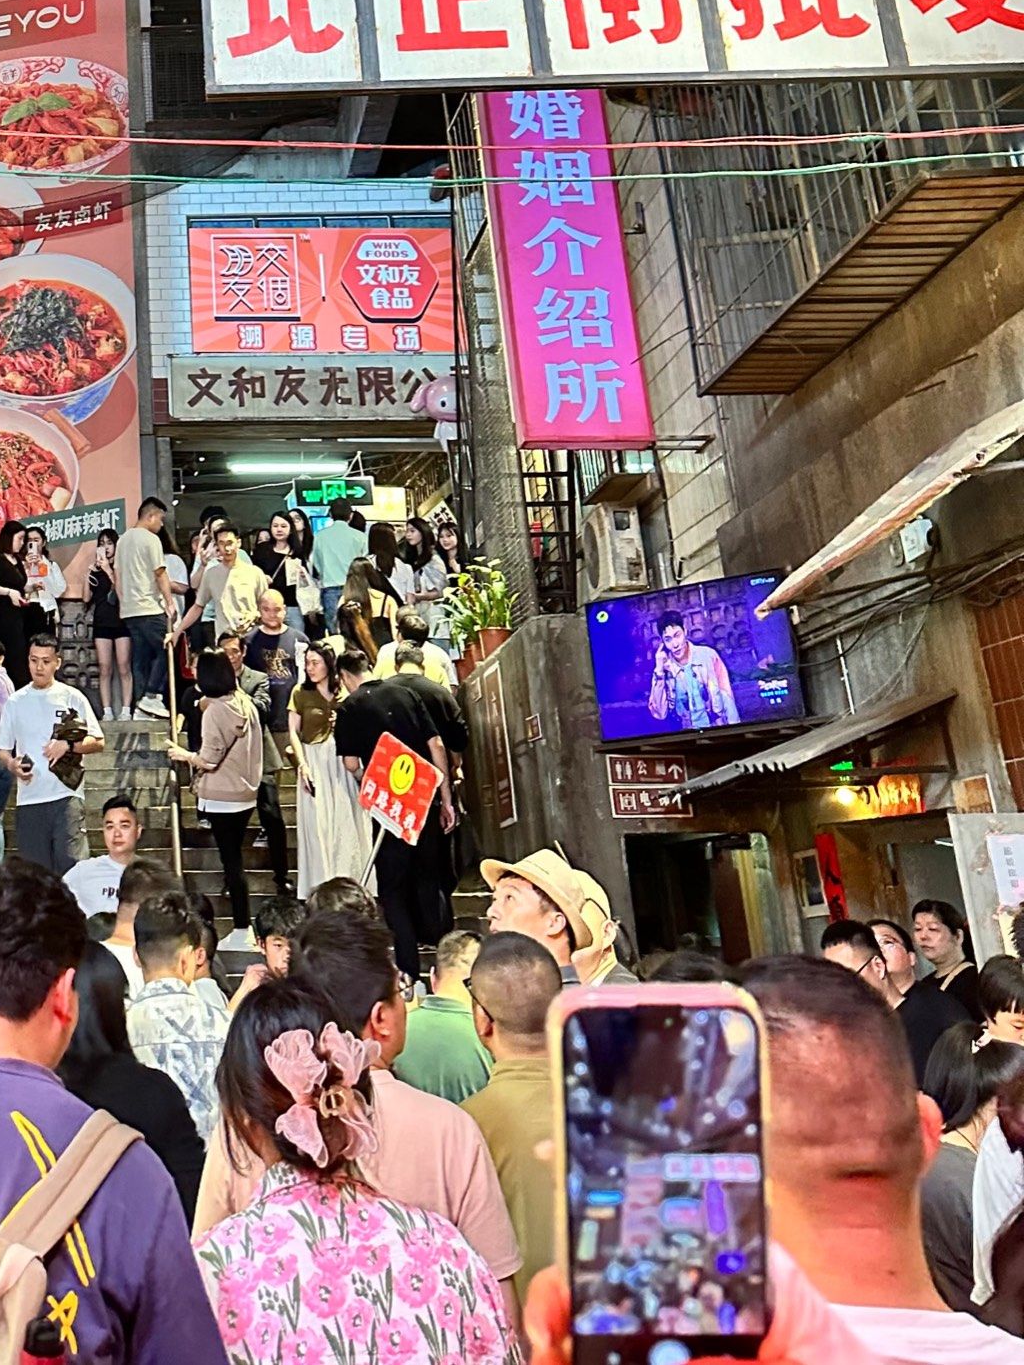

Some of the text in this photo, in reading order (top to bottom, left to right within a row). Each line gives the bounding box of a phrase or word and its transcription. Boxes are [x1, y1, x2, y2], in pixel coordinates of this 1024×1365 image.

[35, 200, 113, 233] 友友卤虾
[365, 250, 409, 258] FOODS
[506, 90, 626, 423] 婚姻介绍所
[355, 264, 422, 285] 文和友
[369, 287, 414, 309] 食品
[237, 323, 422, 351] 溯源专场
[186, 365, 470, 408] 文和友无限公
